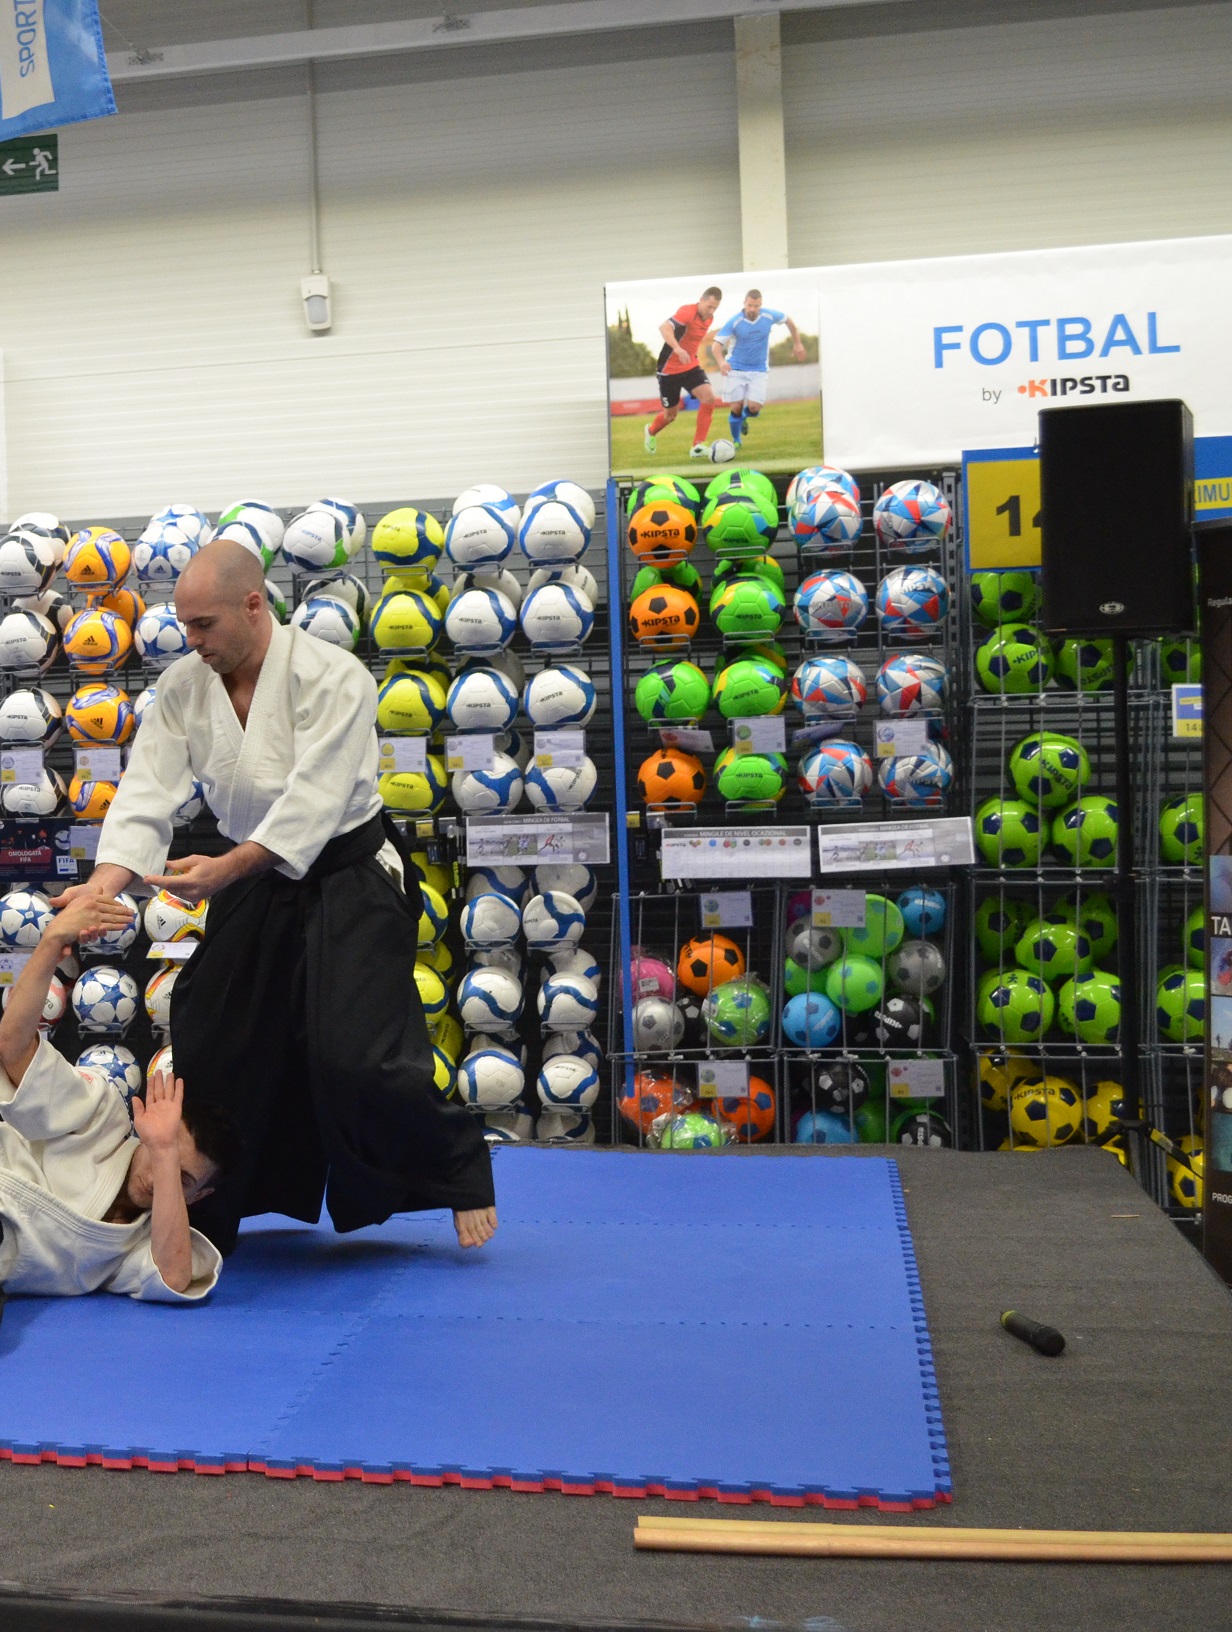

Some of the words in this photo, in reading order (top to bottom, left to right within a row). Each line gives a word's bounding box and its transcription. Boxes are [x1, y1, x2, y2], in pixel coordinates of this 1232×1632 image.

[933, 311, 1181, 369] FOTBAL
[981, 387, 1002, 404] by
[1195, 483, 1232, 504] IMU
